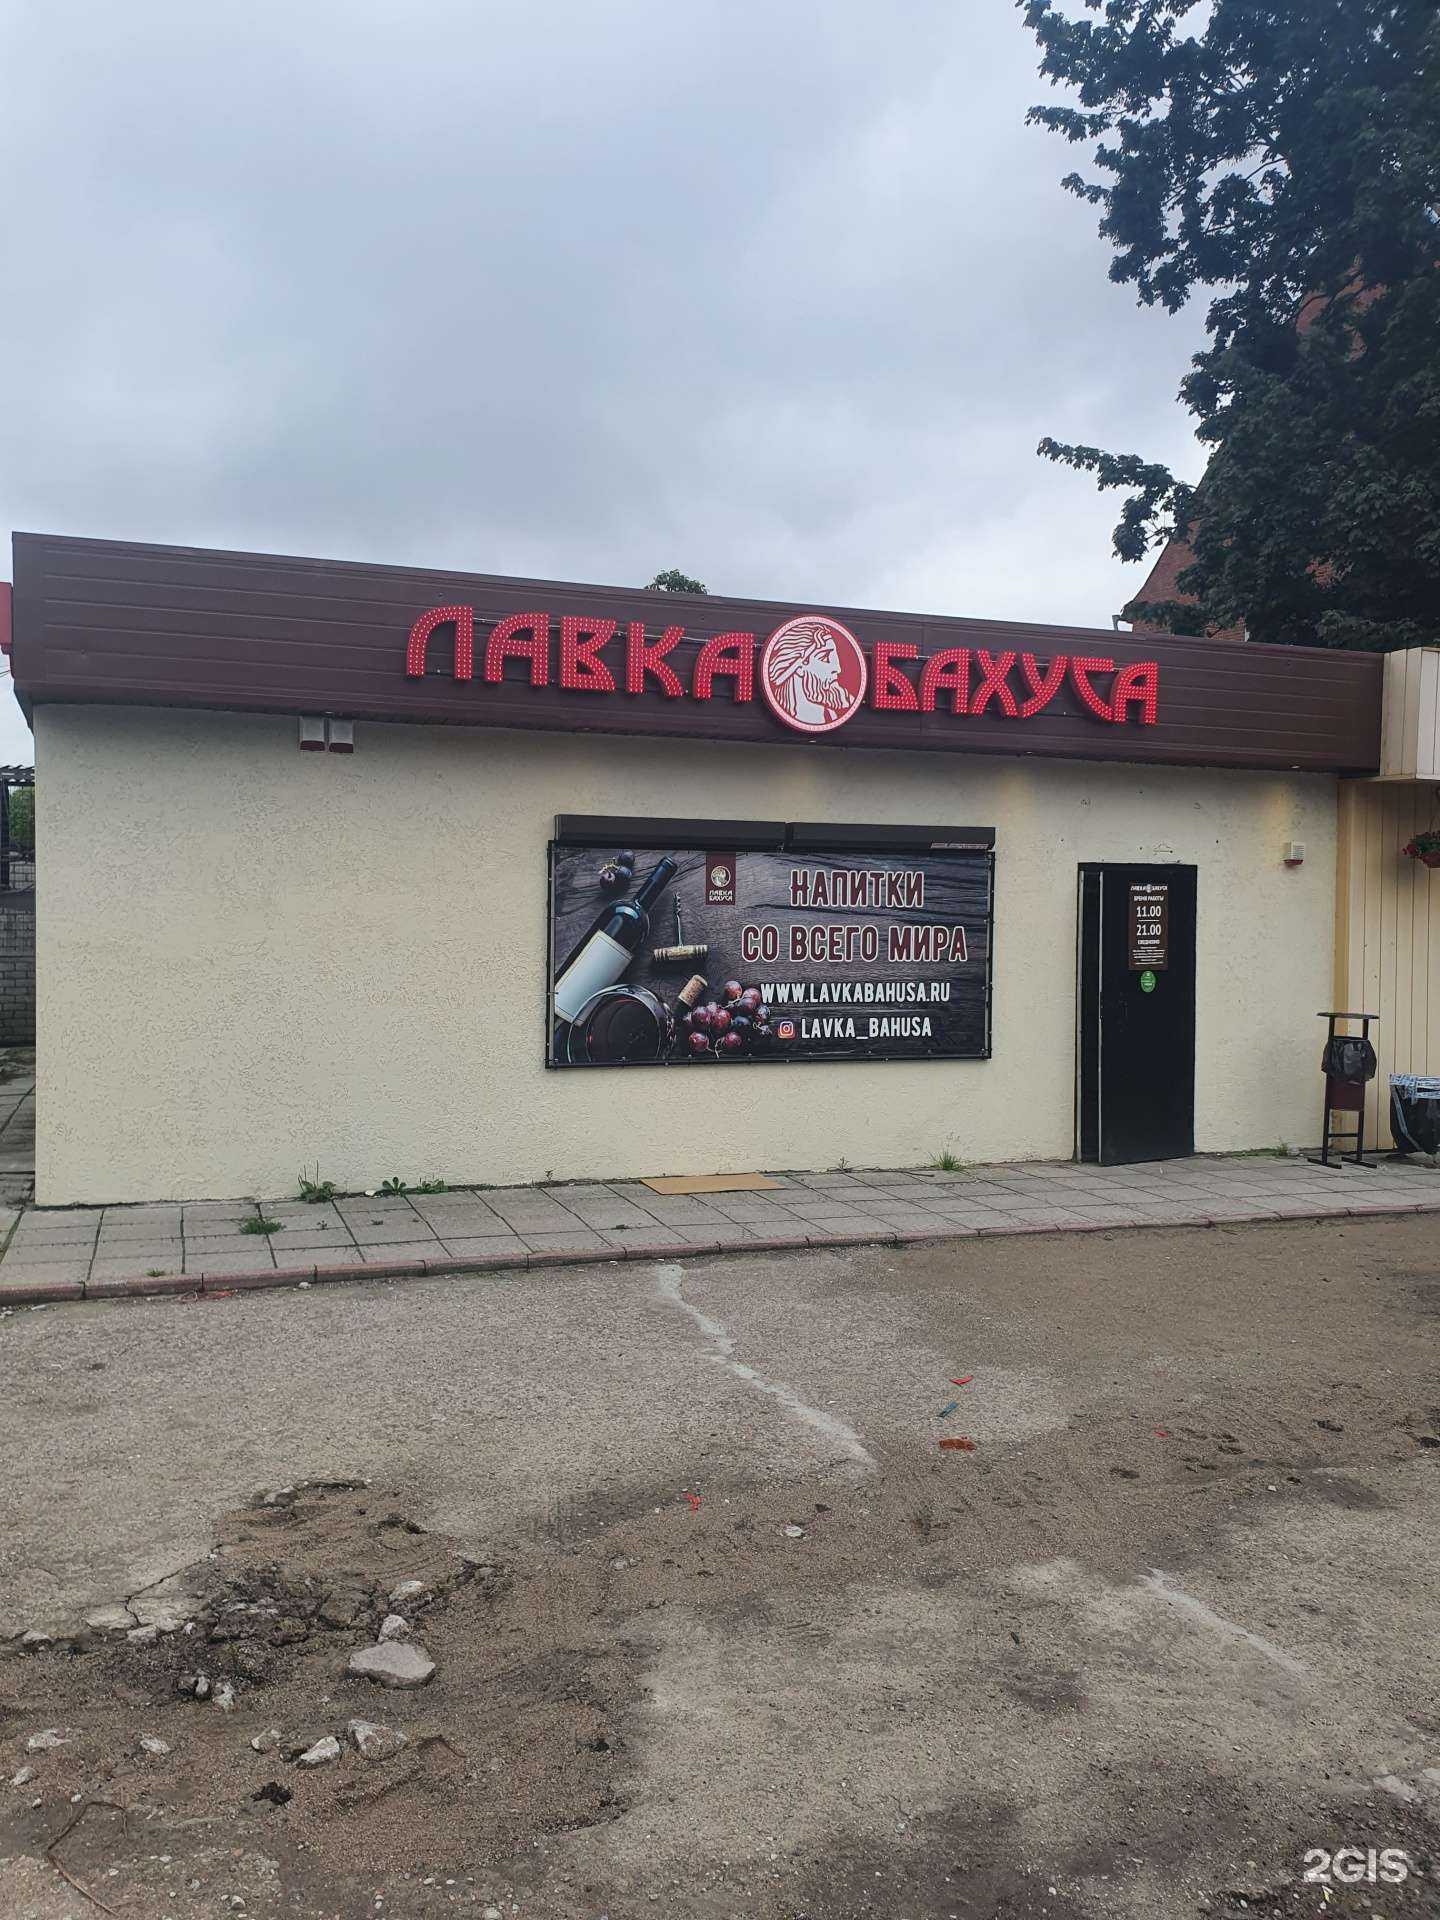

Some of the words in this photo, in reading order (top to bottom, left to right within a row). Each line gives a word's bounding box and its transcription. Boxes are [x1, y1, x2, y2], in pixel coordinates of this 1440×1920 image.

[406, 604, 754, 703] ЛАВКА
[873, 640, 1159, 726] БАХУСА
[790, 869, 925, 908] НАПИТКИ
[1136, 905, 1162, 917] 11.00
[1136, 924, 1162, 936] 21.00
[741, 925, 781, 963] СО
[789, 925, 878, 963] ВСЕГО
[887, 925, 968, 963] МИРА
[761, 981, 951, 1004] WWW.LAVKABAHUSA.RU
[801, 1016, 932, 1040] LAVKA_BAHUSA
